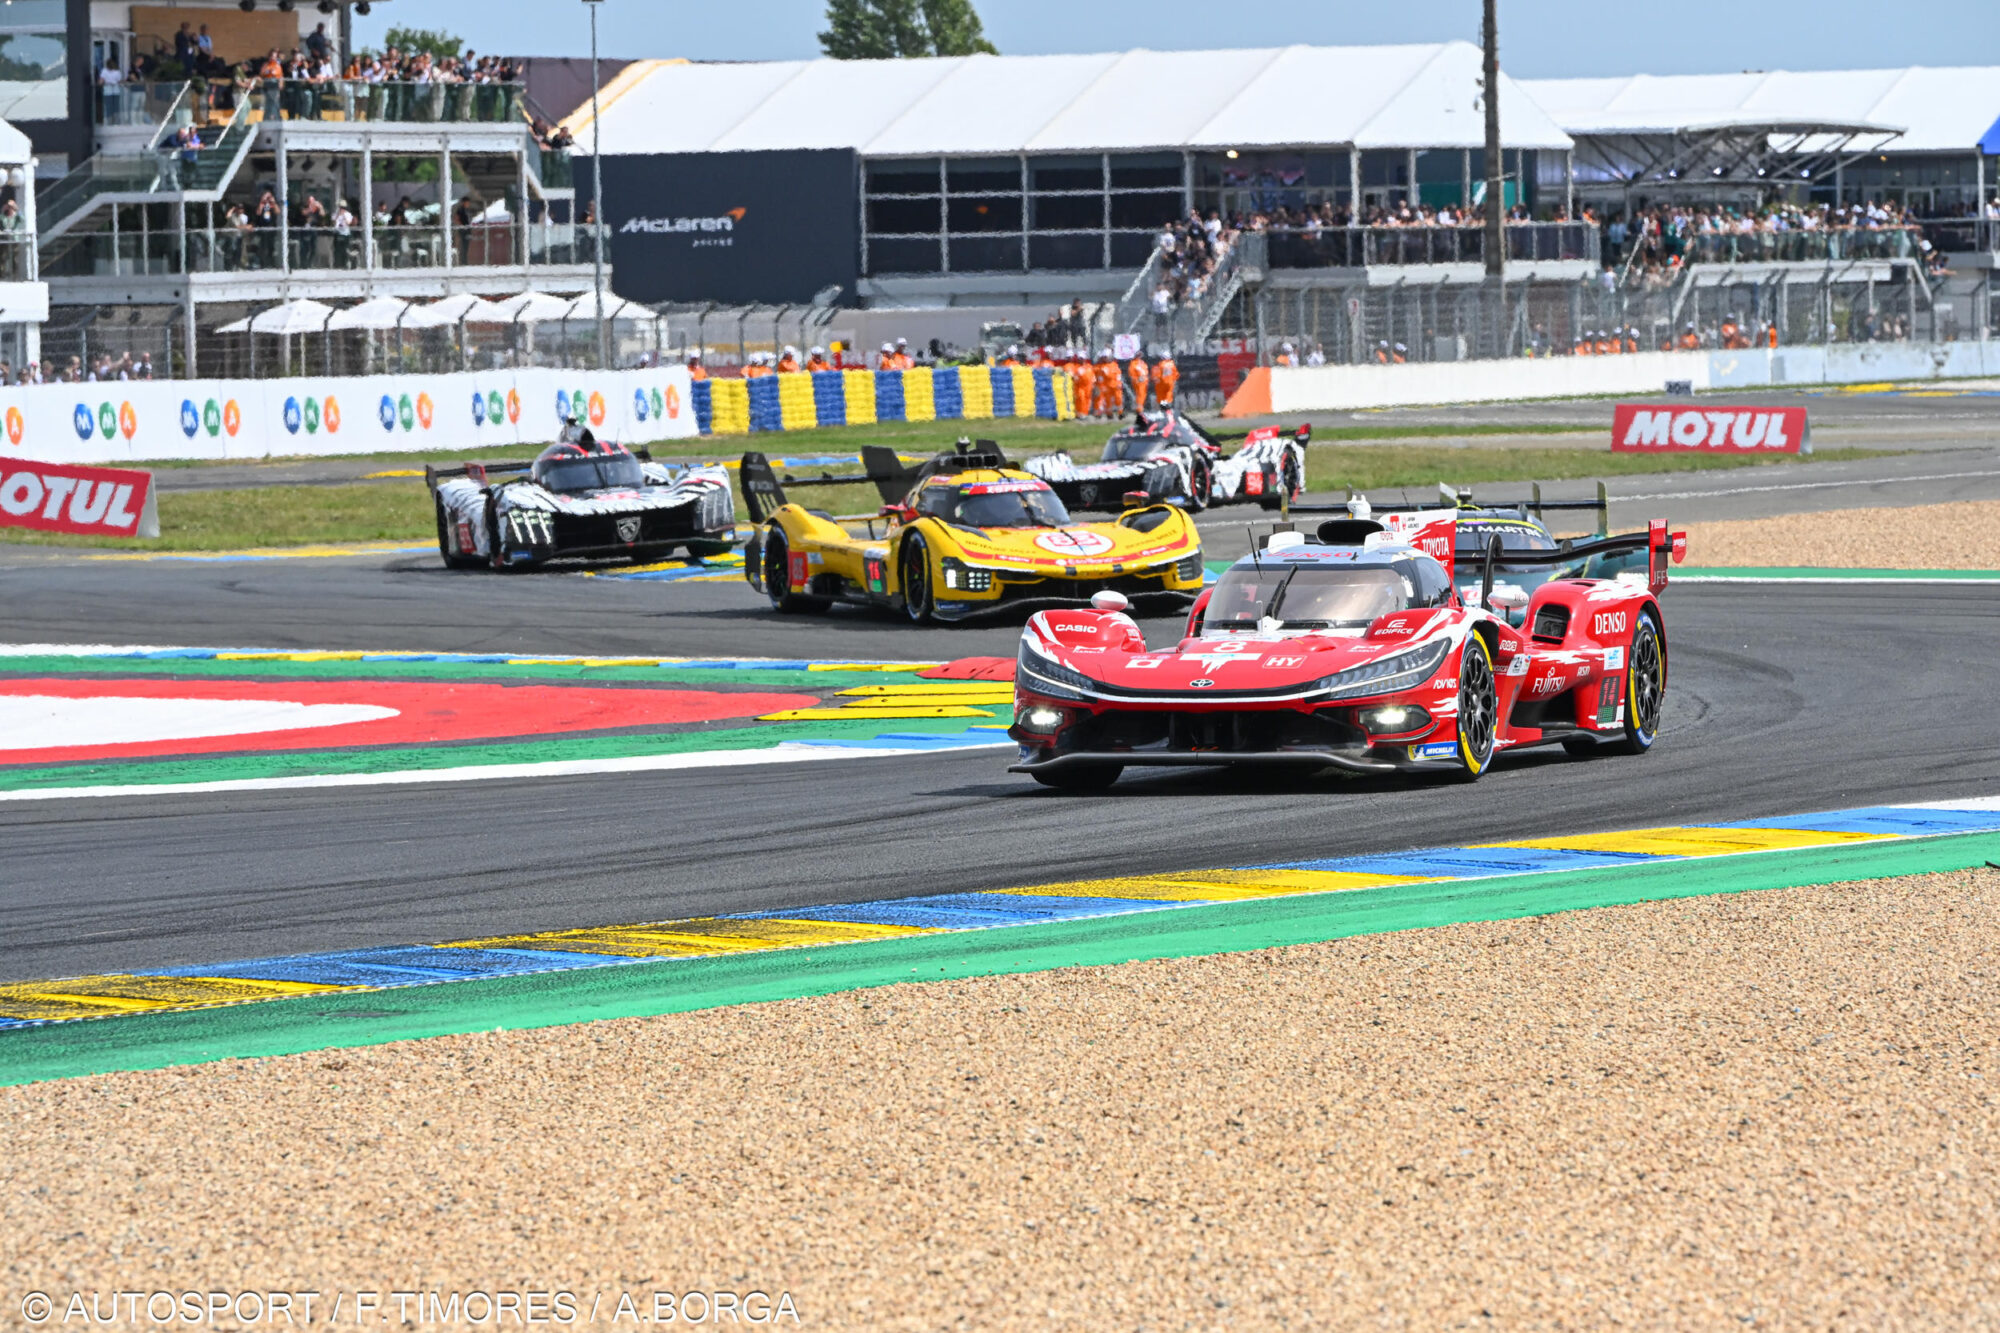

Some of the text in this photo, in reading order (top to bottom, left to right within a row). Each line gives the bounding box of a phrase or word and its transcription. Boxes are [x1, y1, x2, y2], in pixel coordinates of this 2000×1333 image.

[620, 216, 733, 233] McLaren
[1623, 410, 1788, 448] MOTUL
[0, 471, 137, 528] OTUL
[1477, 523, 1541, 538] MARTIN
[1422, 536, 1450, 557] TOYOTA
[1266, 550, 1353, 559] DENSO
[1055, 623, 1098, 634] CASIO
[1594, 611, 1626, 635] DENSO
[1374, 627, 1415, 636] EDIFICE
[1213, 641, 1248, 653] 8
[1266, 656, 1302, 667] HY
[1532, 676, 1566, 696] FUJITSU
[1425, 746, 1455, 755] MICHELIN
